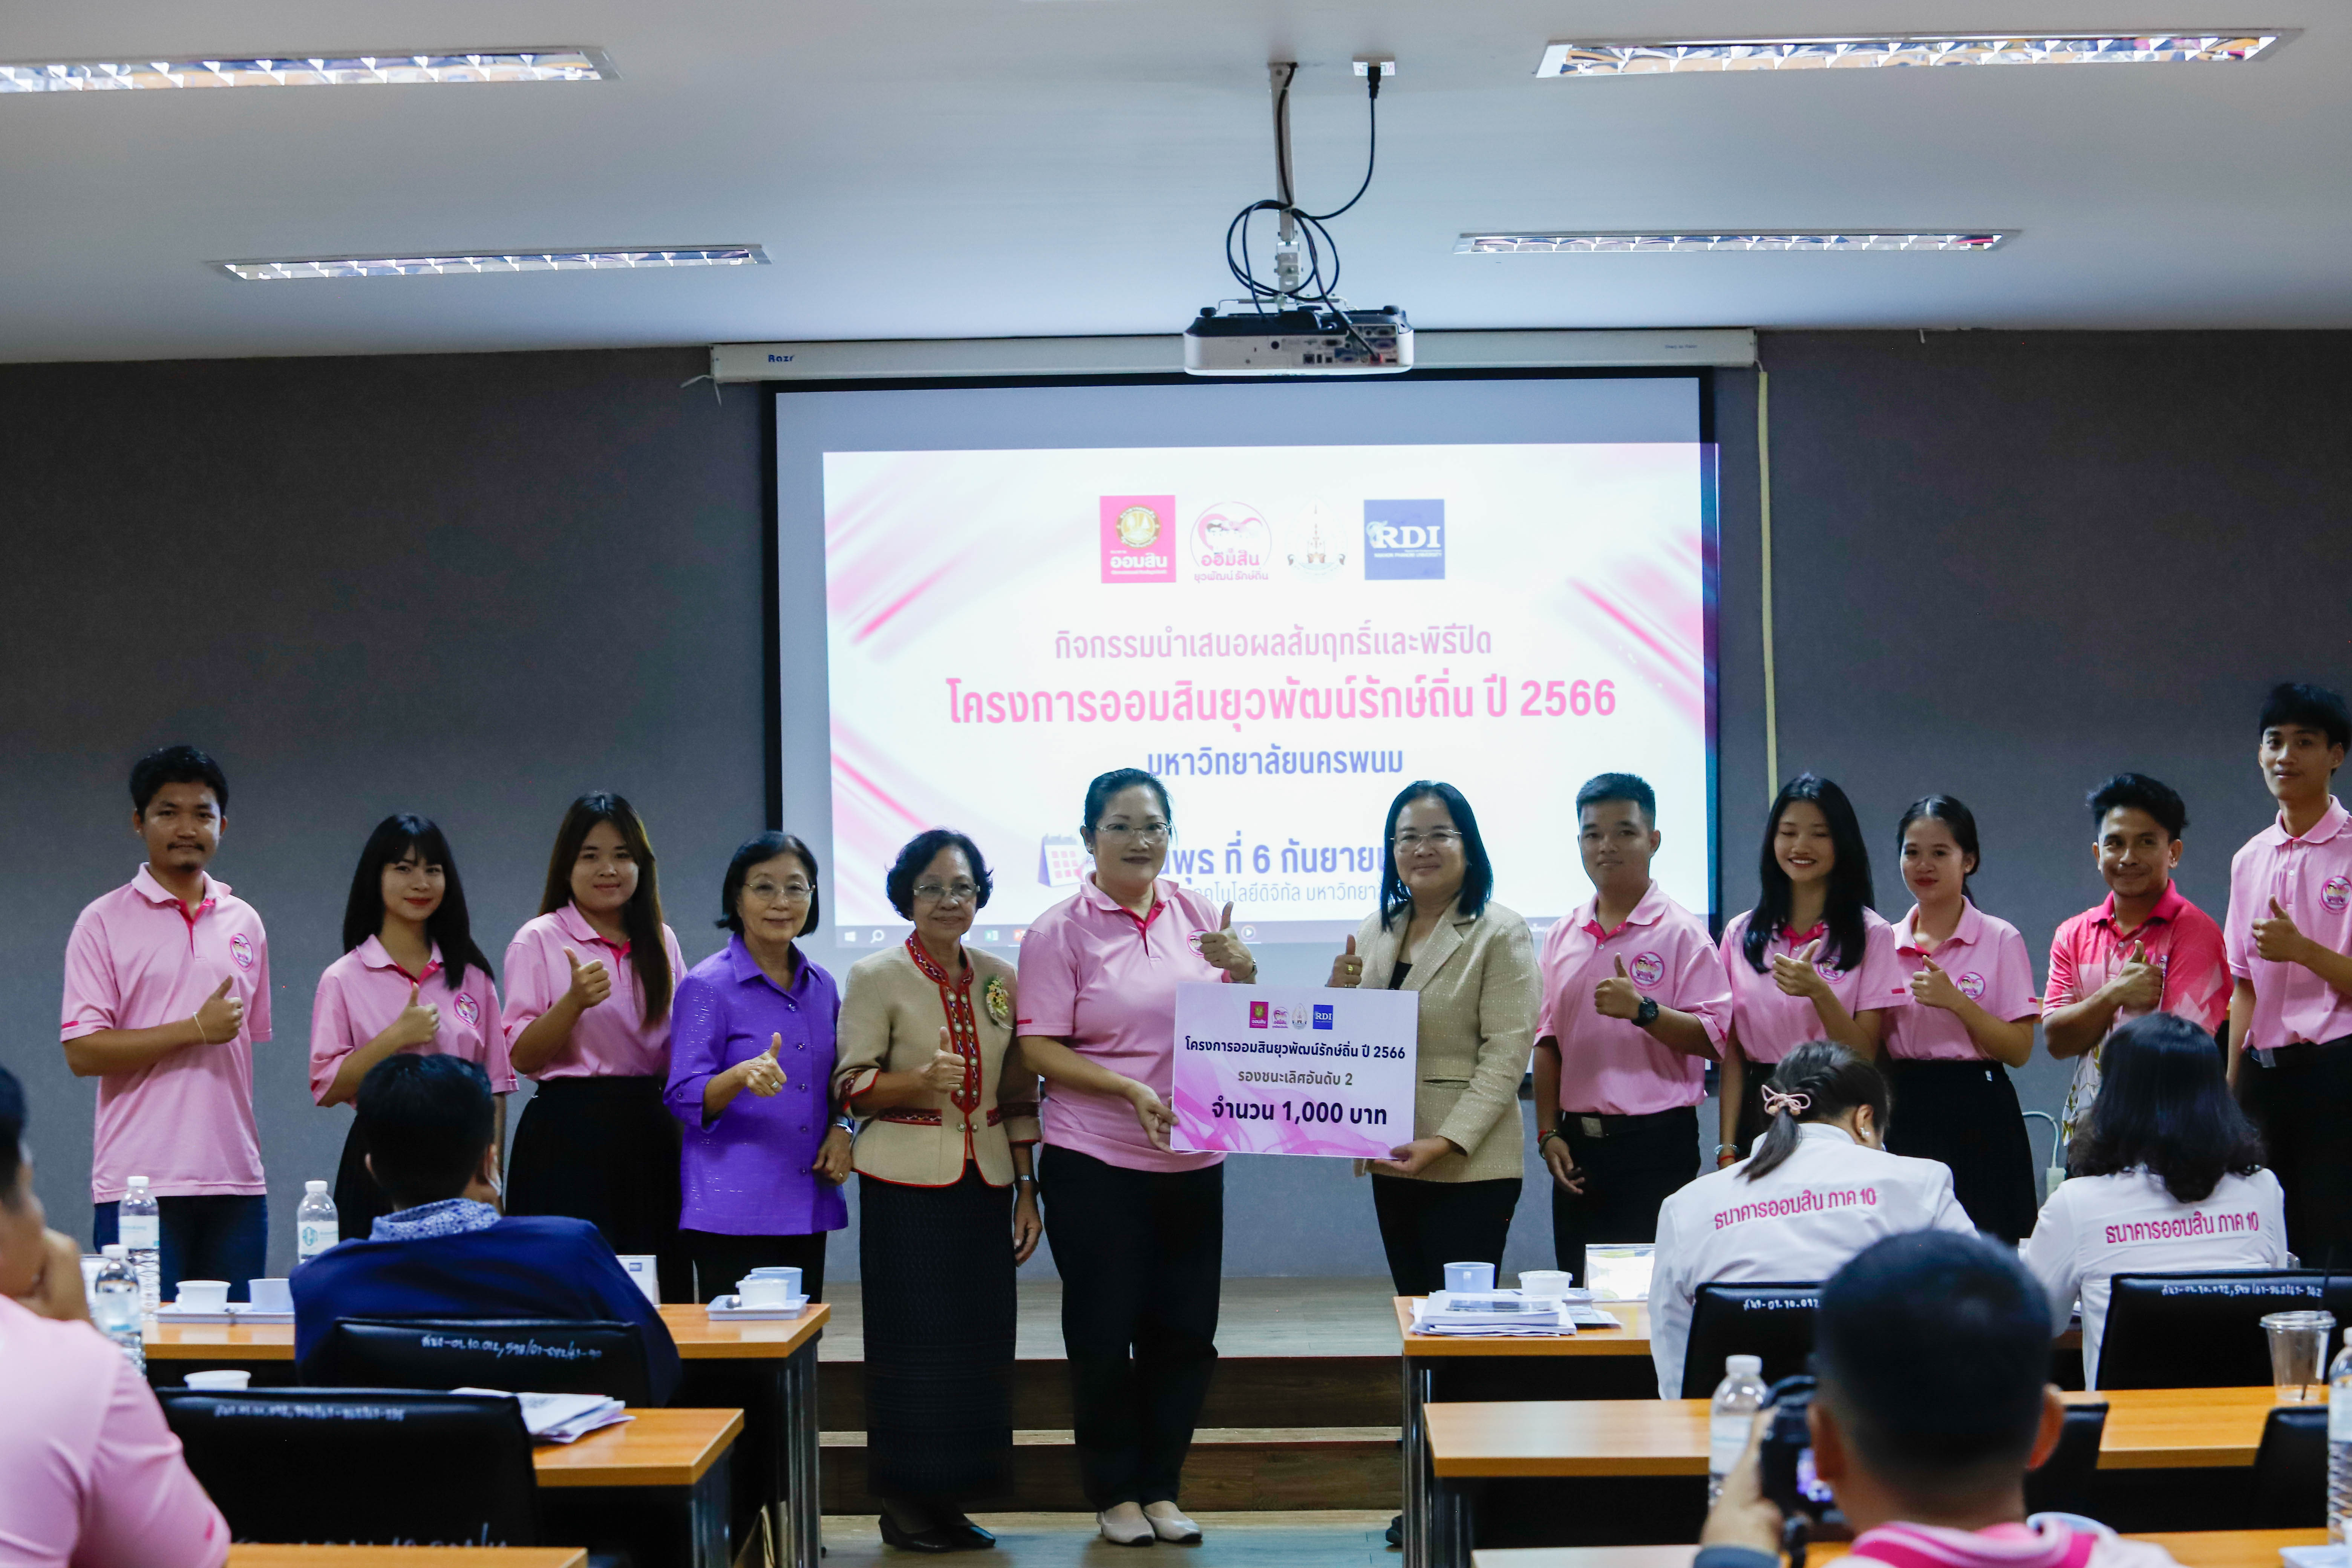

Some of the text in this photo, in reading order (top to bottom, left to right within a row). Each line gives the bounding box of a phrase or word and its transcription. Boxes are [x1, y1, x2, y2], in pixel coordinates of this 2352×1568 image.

[1375, 526, 1441, 548] RDI
[1110, 552, 1168, 568] ออมสิน
[1055, 619, 1491, 663] กิจกรรมนำเสนอผลสัมฤทธิ์และพิธีปิด
[946, 668, 1616, 732] โครงการออมสินยุวพัฒน์รักษ์ถิ่น ปี 2566
[1147, 743, 1403, 776] มหาวิทยาลัยนครพนม
[1225, 830, 1242, 874] ที่
[1253, 845, 1271, 874] 6
[1281, 838, 1384, 873] กันยาย
[1185, 1036, 1406, 1059] โครงการออมสินยุวพัฒน์รักษ์ถิ่น ปี 2566
[1238, 1070, 1353, 1086] รองชนะเลิศอันดับ 2
[1212, 1095, 1387, 1125] จำนวน 1,000 บาท
[1714, 1188, 1877, 1230] ธนาคารออมสิน ภาค 10
[2105, 1210, 2259, 1244] ธนาคารออมสิน ภาค 10
